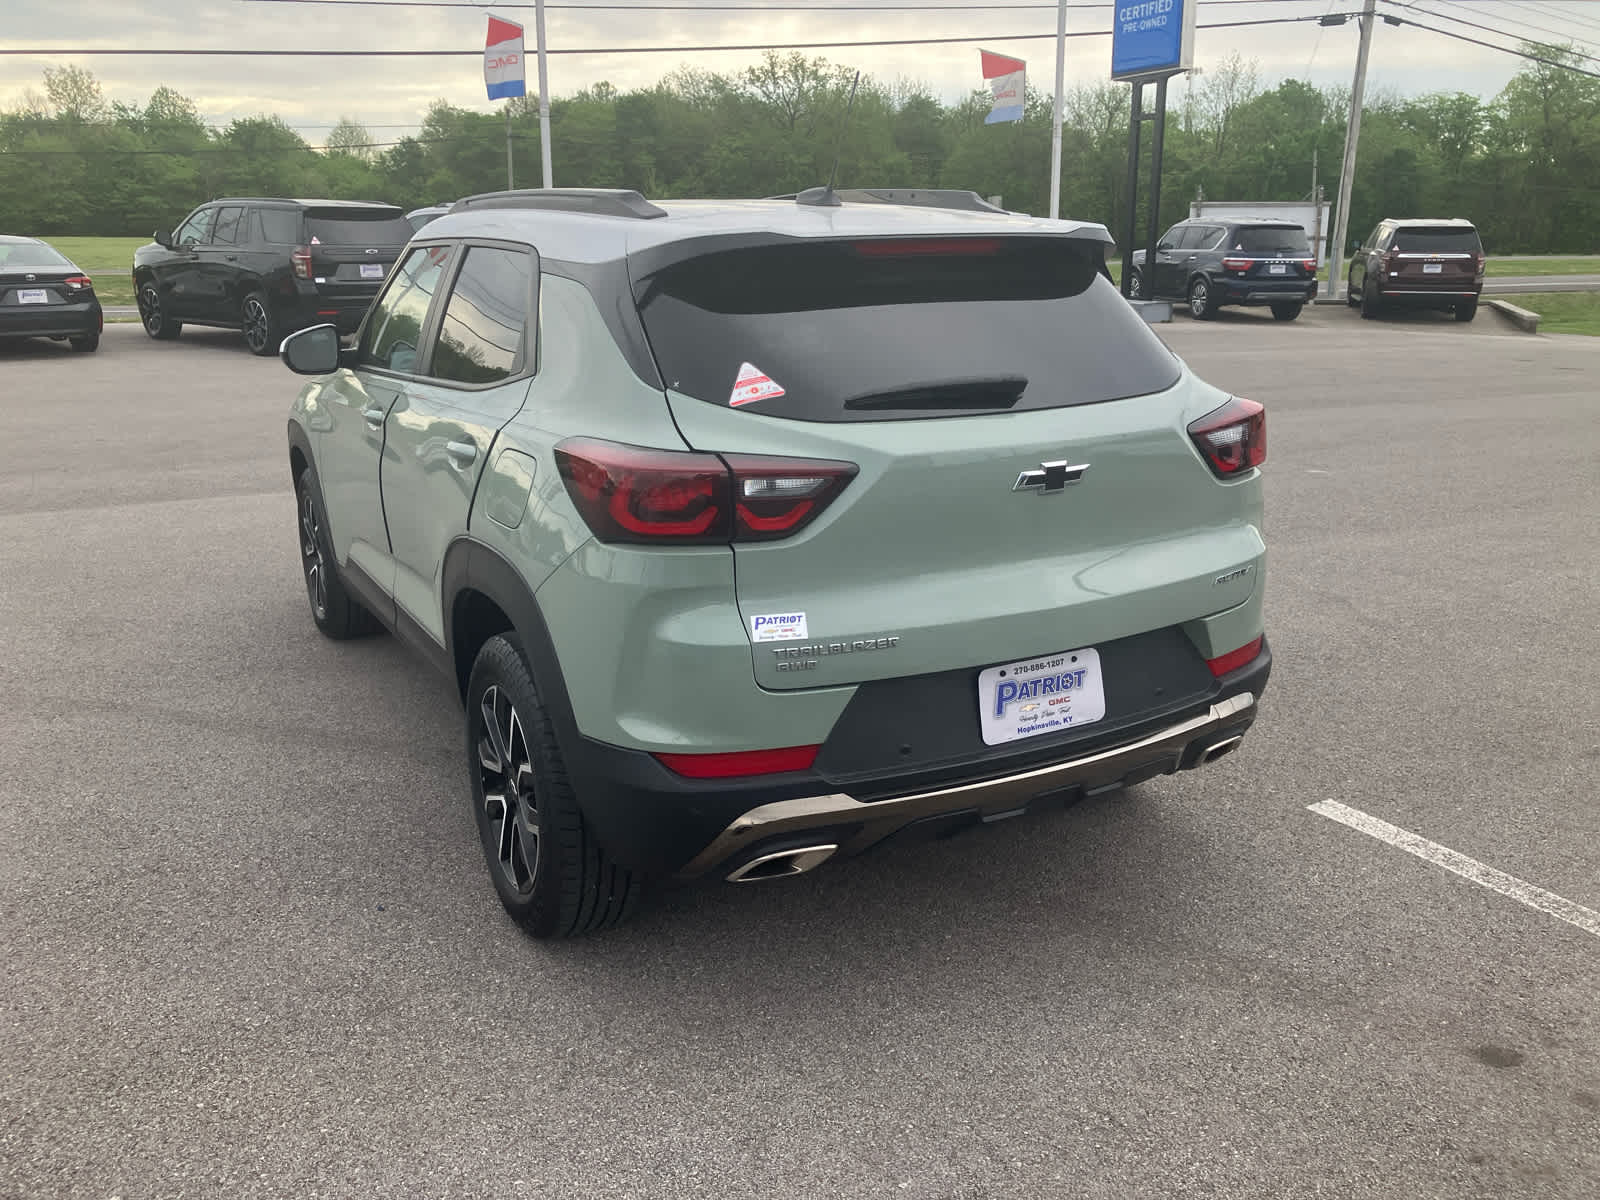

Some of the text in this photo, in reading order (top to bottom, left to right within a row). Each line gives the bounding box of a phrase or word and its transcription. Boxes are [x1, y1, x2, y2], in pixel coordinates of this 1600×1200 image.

[1120, 0, 1173, 21] CERTIFIED
[1122, 15, 1167, 32] PRE-OWNED
[754, 615, 803, 630] PATRIOT
[772, 636, 900, 660] TRAILBLAZER
[995, 669, 1086, 716] PATRIOT
[1048, 696, 1071, 706] GMC
[1017, 715, 1073, 734] Hopkinsville, KY
